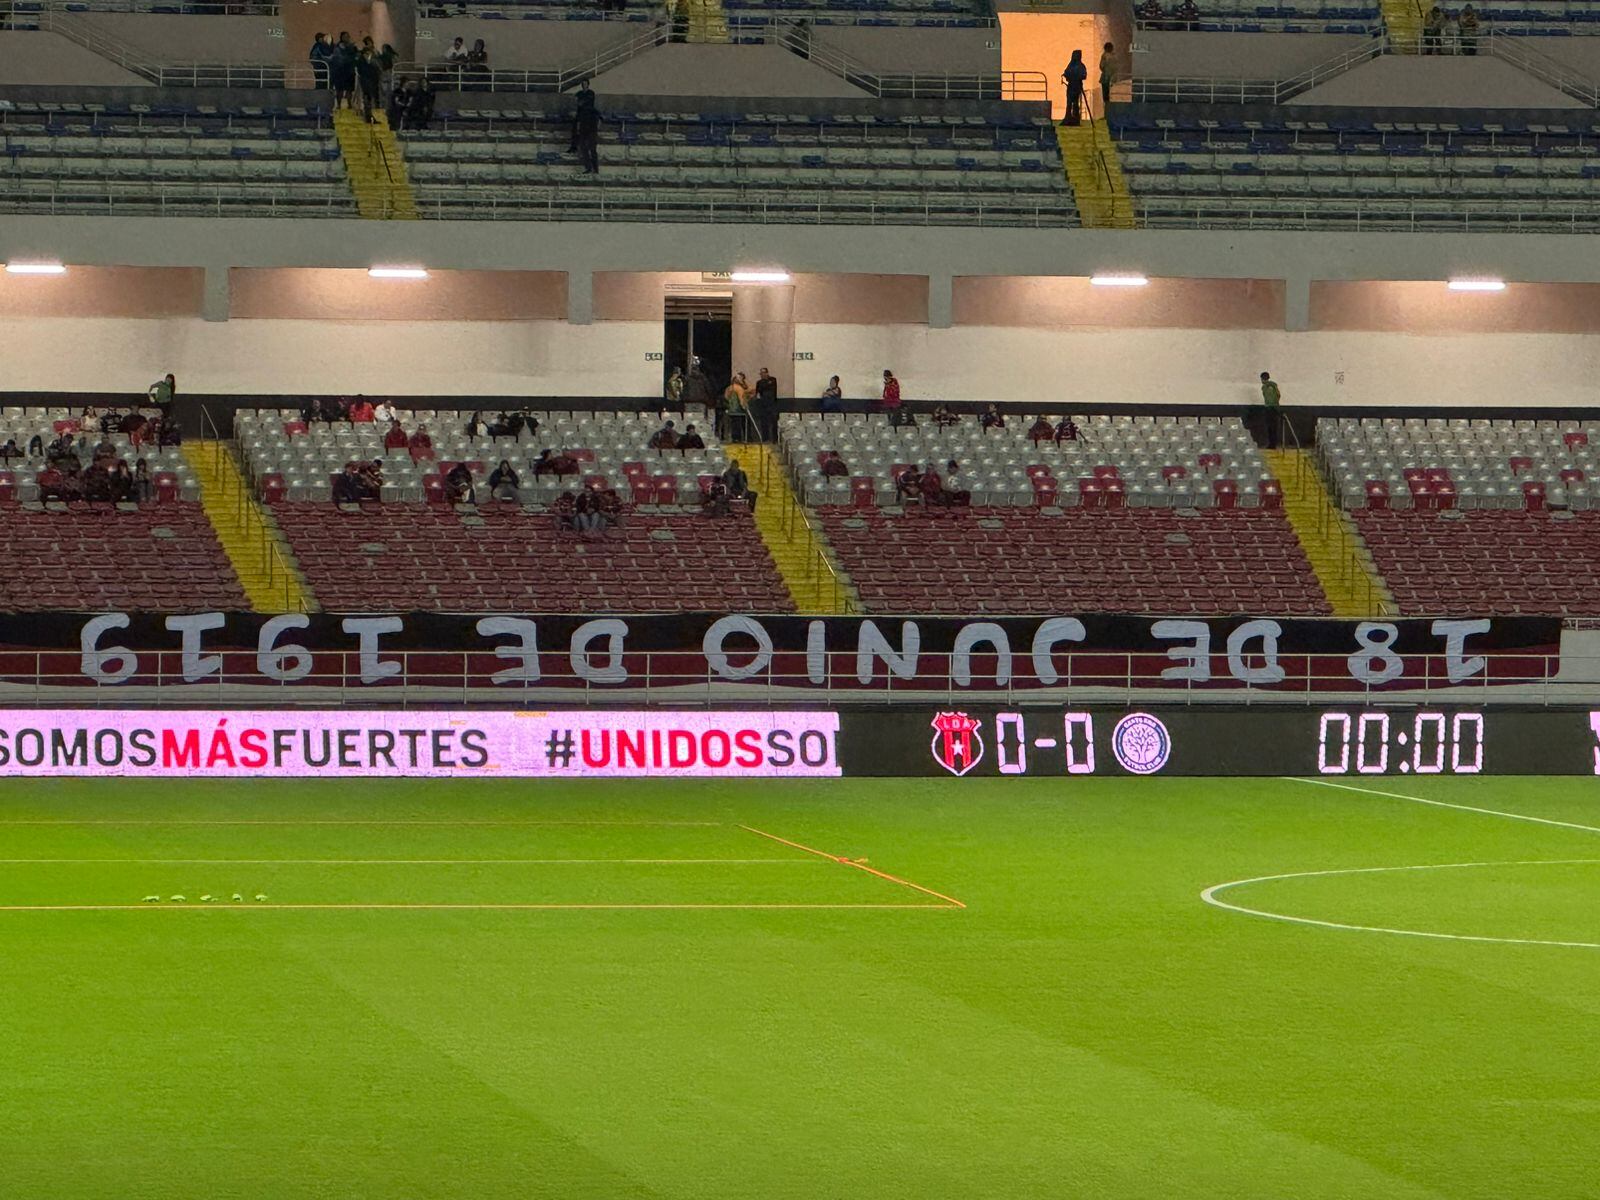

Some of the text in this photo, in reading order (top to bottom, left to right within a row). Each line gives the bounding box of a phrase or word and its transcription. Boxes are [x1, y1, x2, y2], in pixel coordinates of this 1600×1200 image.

[81, 612, 1491, 685] 18 DE JUNIO DE 1919
[545, 728, 828, 769] #UNIDOSSO
[1318, 712, 1484, 774] 00:00
